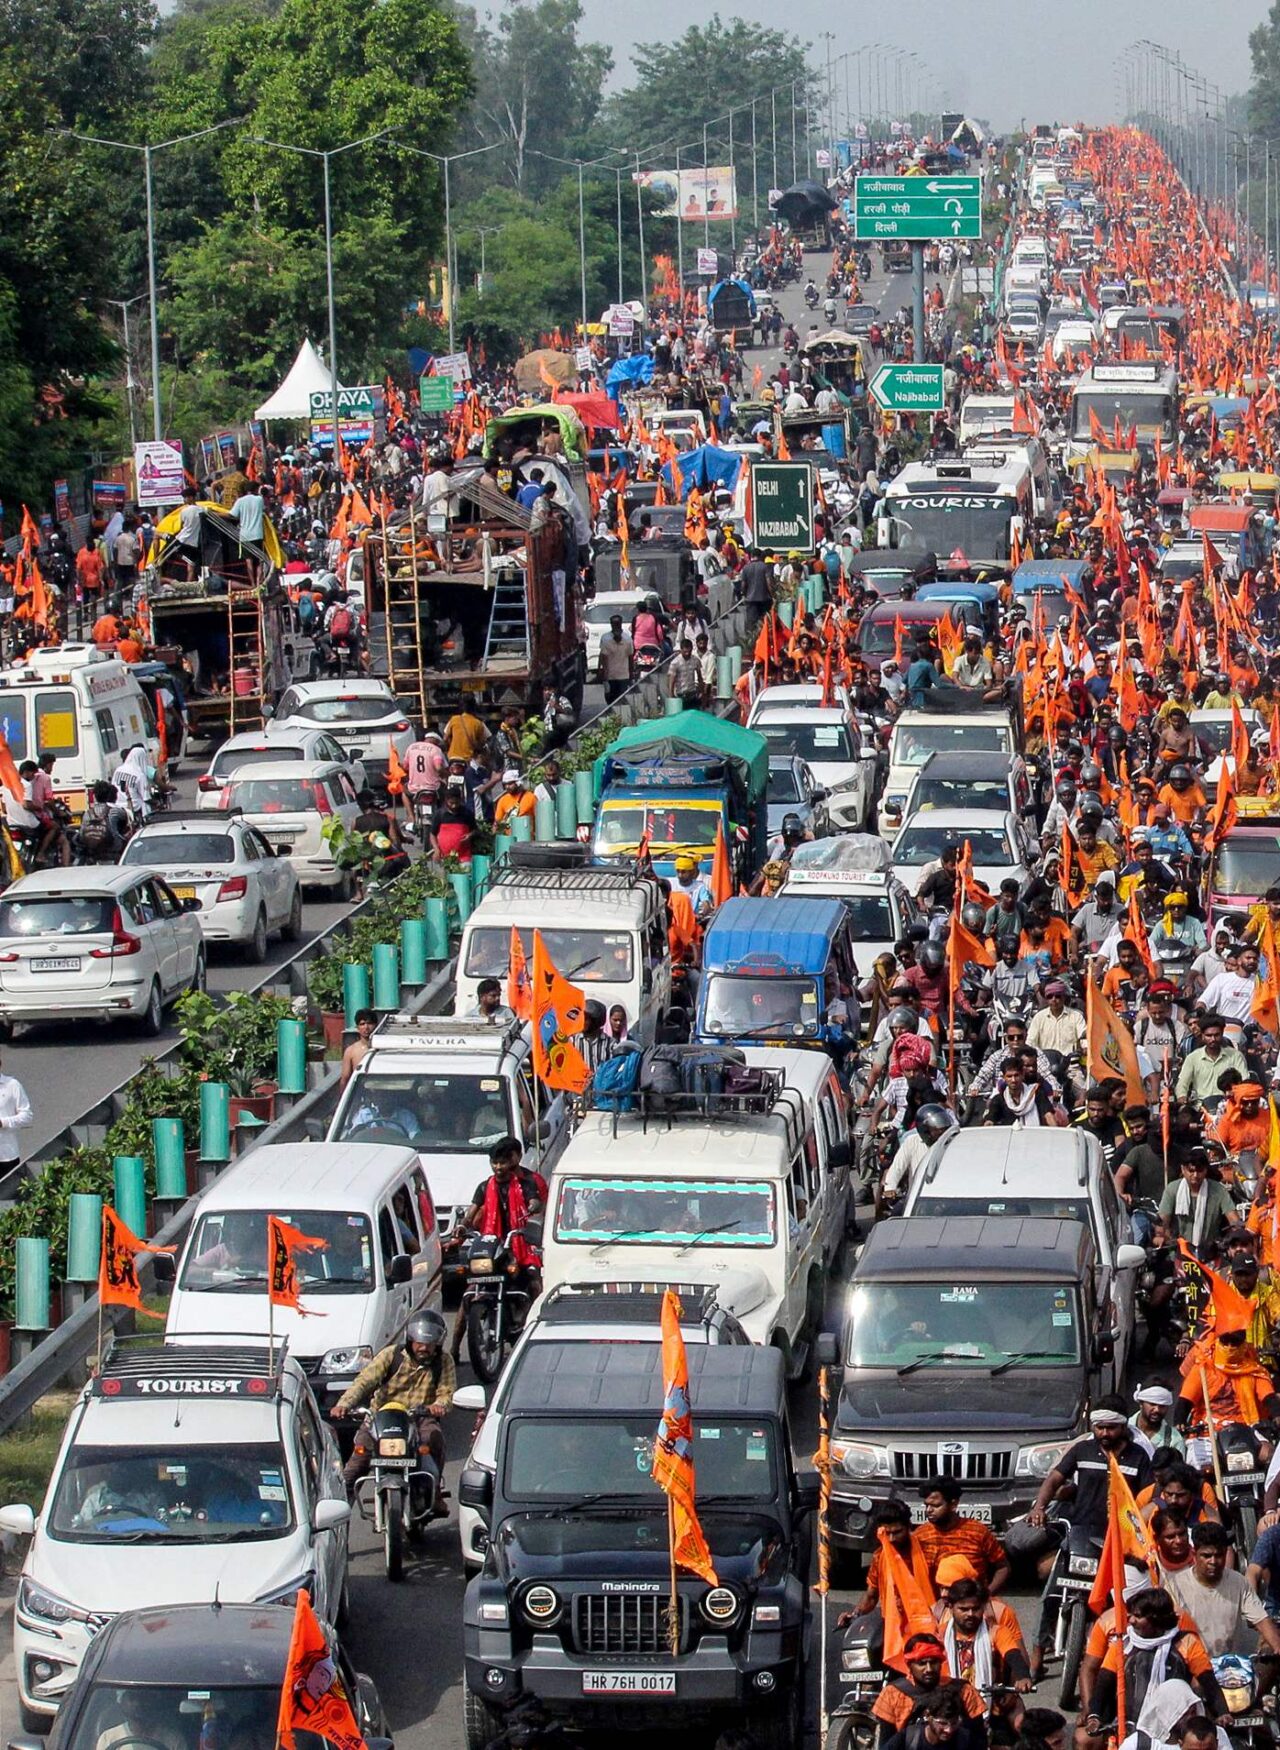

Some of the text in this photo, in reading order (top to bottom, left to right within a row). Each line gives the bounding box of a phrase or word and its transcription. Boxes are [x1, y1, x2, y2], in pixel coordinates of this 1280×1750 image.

[875, 221, 898, 233] दिल्ली
[894, 391, 940, 403] Najibabad
[757, 480, 779, 496] DELHI
[896, 497, 1005, 510] TOURIST
[758, 521, 800, 537] NAZIBABAD
[416, 755, 425, 773] 8
[841, 873, 867, 881] TOURIST
[136, 1379, 242, 1393] TOURIST
[602, 1582, 660, 1591] Mahindra
[591, 1676, 674, 1690] HR 76H 0017
